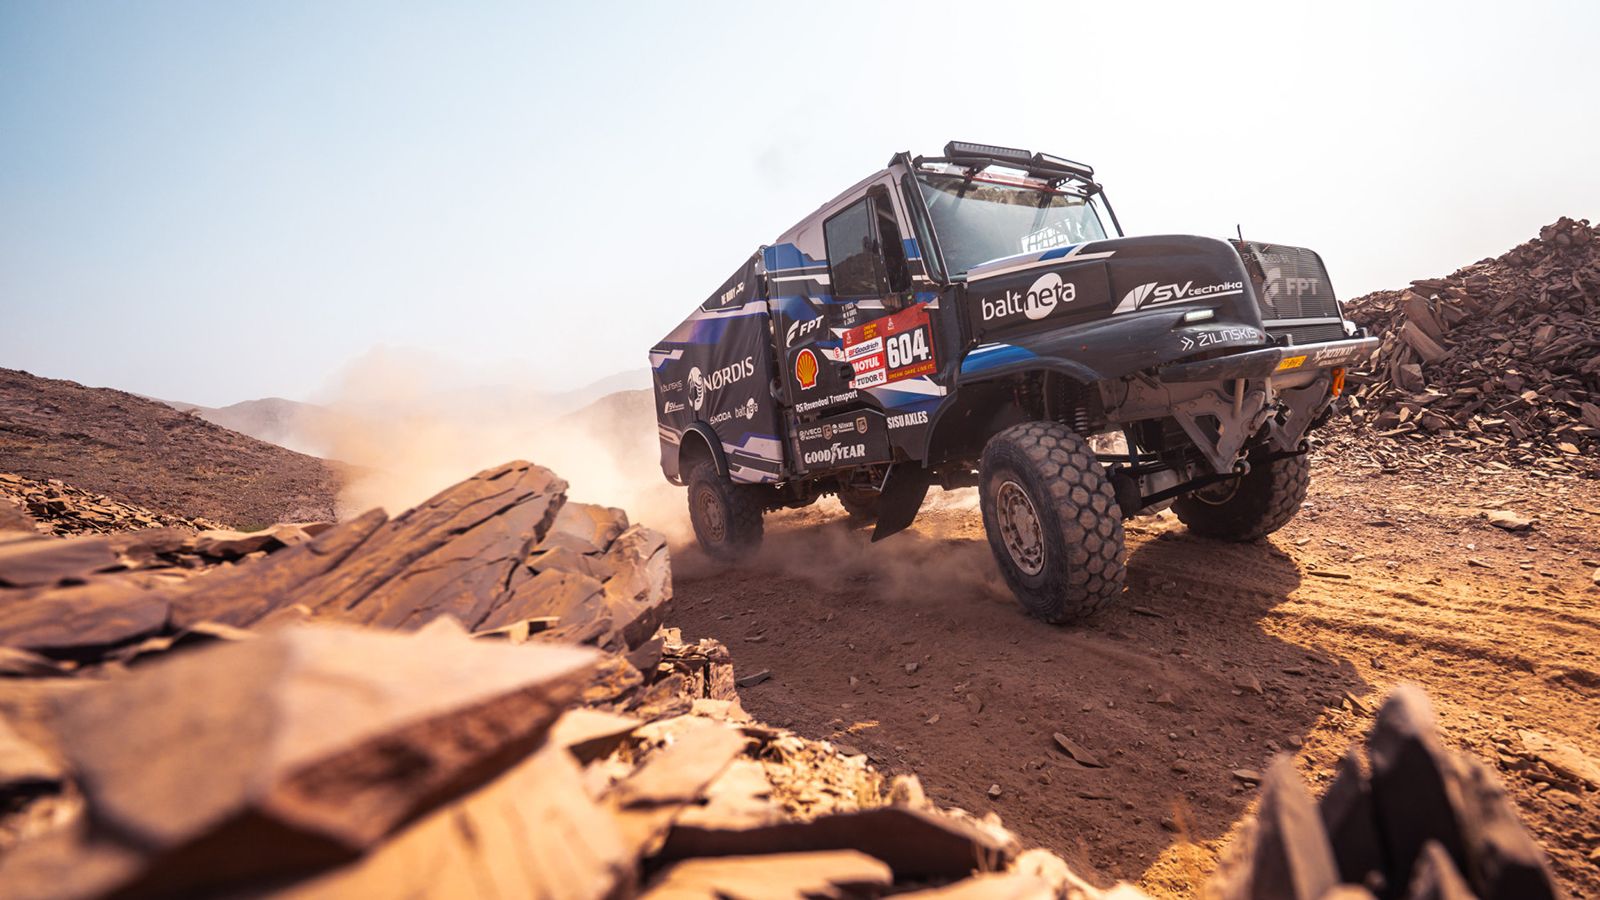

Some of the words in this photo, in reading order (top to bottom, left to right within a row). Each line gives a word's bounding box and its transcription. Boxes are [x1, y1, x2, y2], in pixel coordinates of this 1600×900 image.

[1286, 277, 1320, 295] FPT
[981, 282, 1076, 321] baltneta
[799, 314, 825, 336] FPT
[852, 356, 880, 373] MOTUL
[703, 356, 754, 393] NØRDIS
[857, 374, 879, 386] TUDOR
[829, 389, 858, 404] Transport
[904, 410, 928, 426] AXLES
